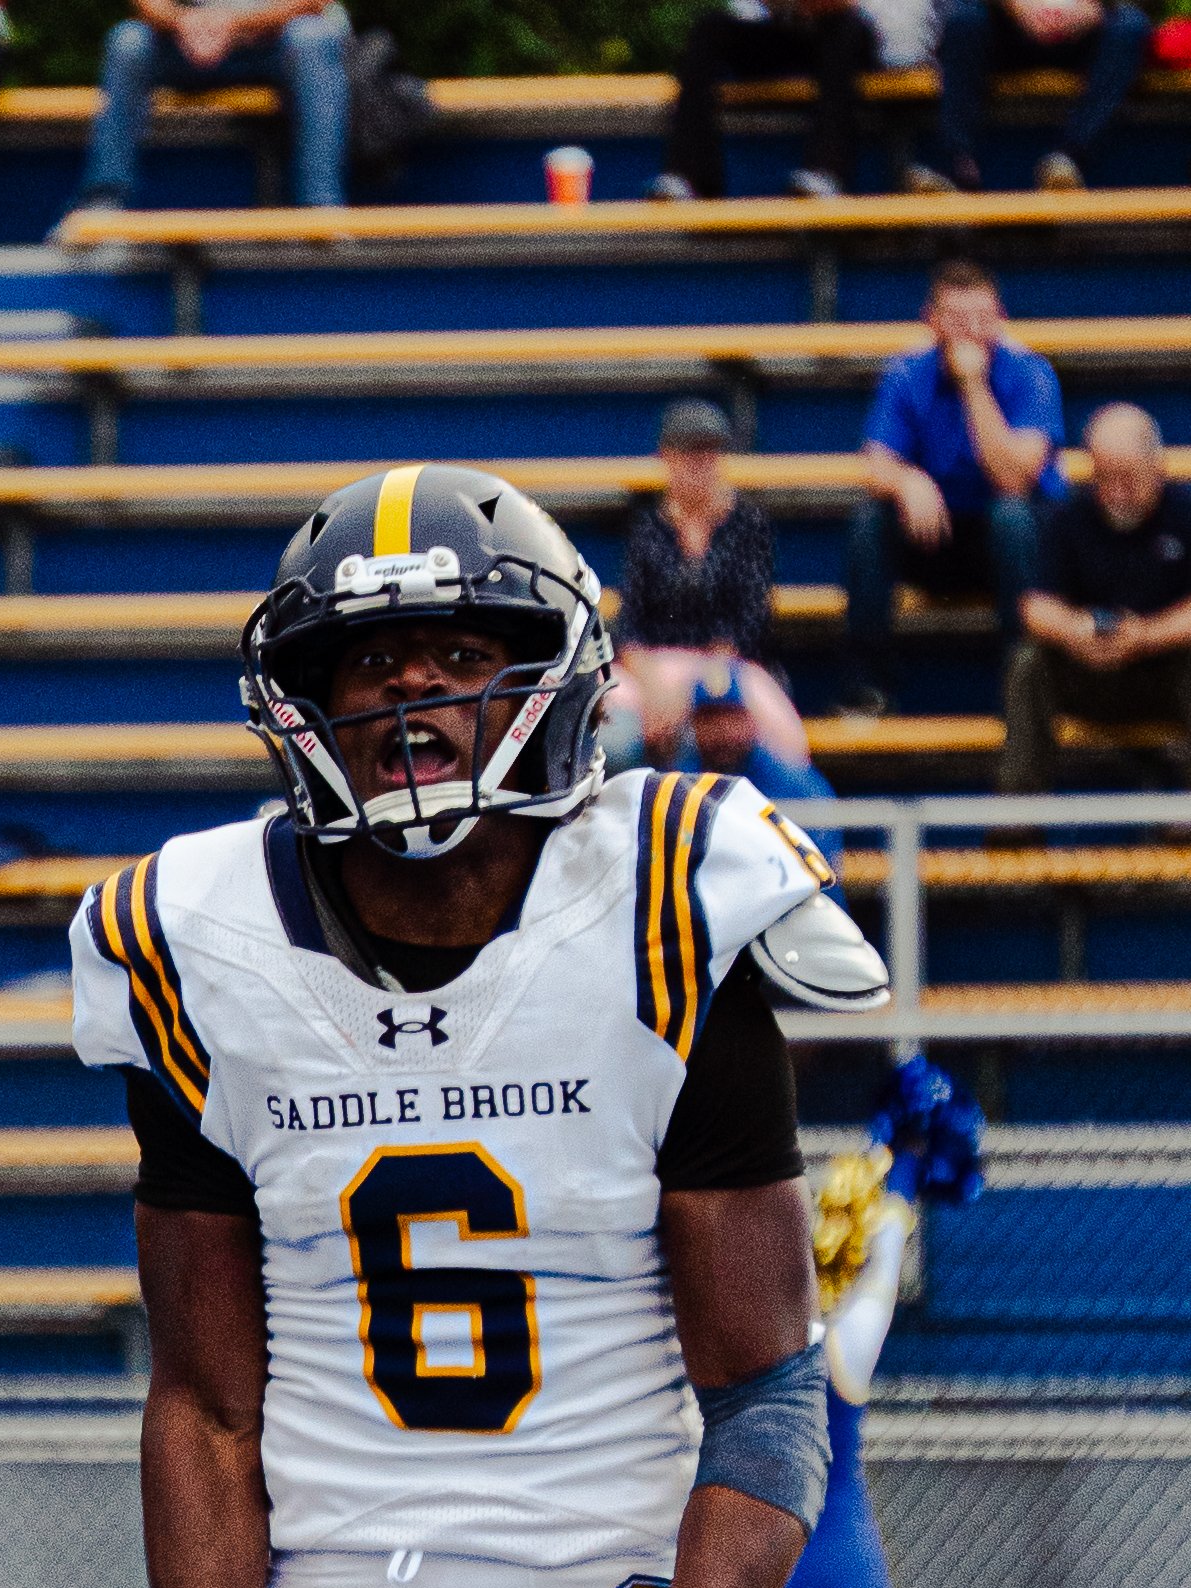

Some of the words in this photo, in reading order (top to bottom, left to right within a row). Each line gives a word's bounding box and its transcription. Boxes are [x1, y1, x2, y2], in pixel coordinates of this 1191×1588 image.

[267, 1088, 421, 1131] SADDLE
[441, 1079, 591, 1120] BROOK
[339, 1140, 543, 1435] 6
